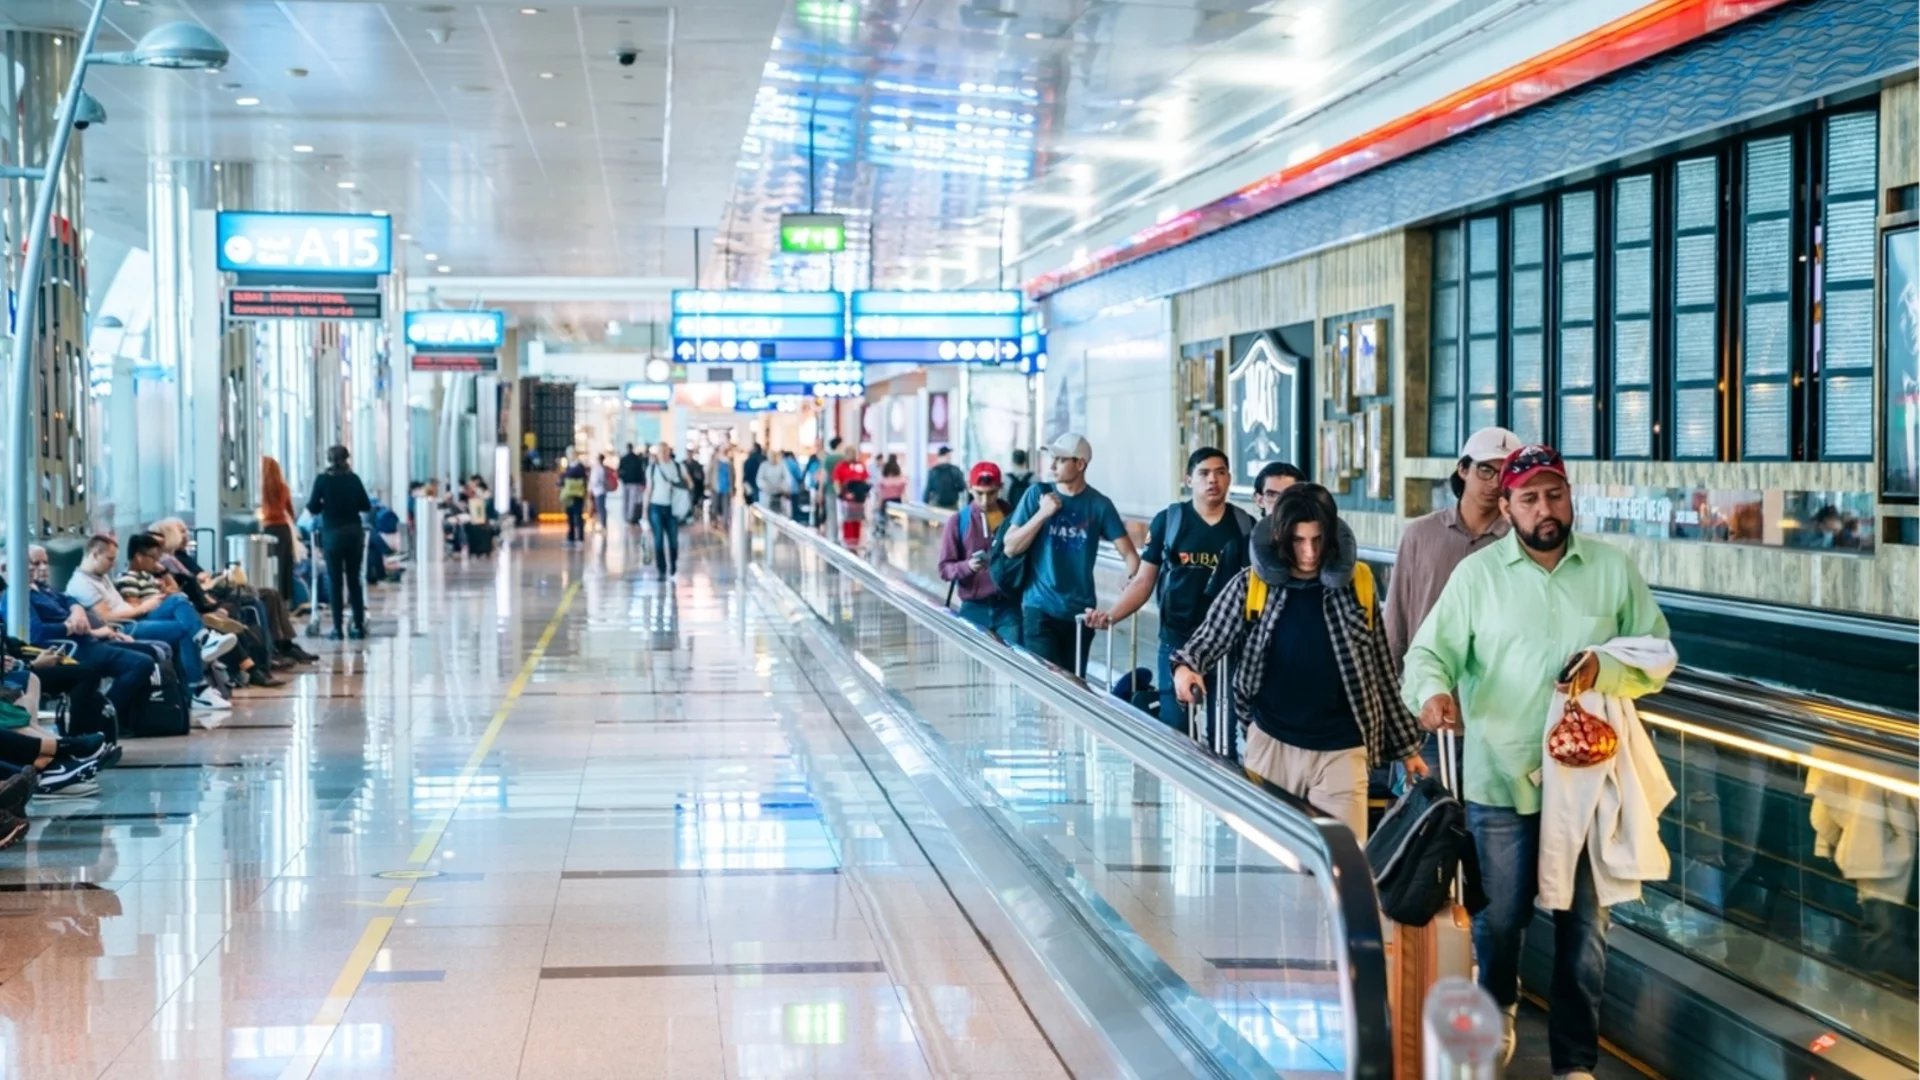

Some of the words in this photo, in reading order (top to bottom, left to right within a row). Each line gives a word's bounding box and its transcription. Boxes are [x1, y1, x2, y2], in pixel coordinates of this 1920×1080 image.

[294, 227, 379, 267] A15
[448, 319, 498, 343] A14
[1049, 524, 1087, 540] NASA
[1179, 552, 1221, 566] DUBA
